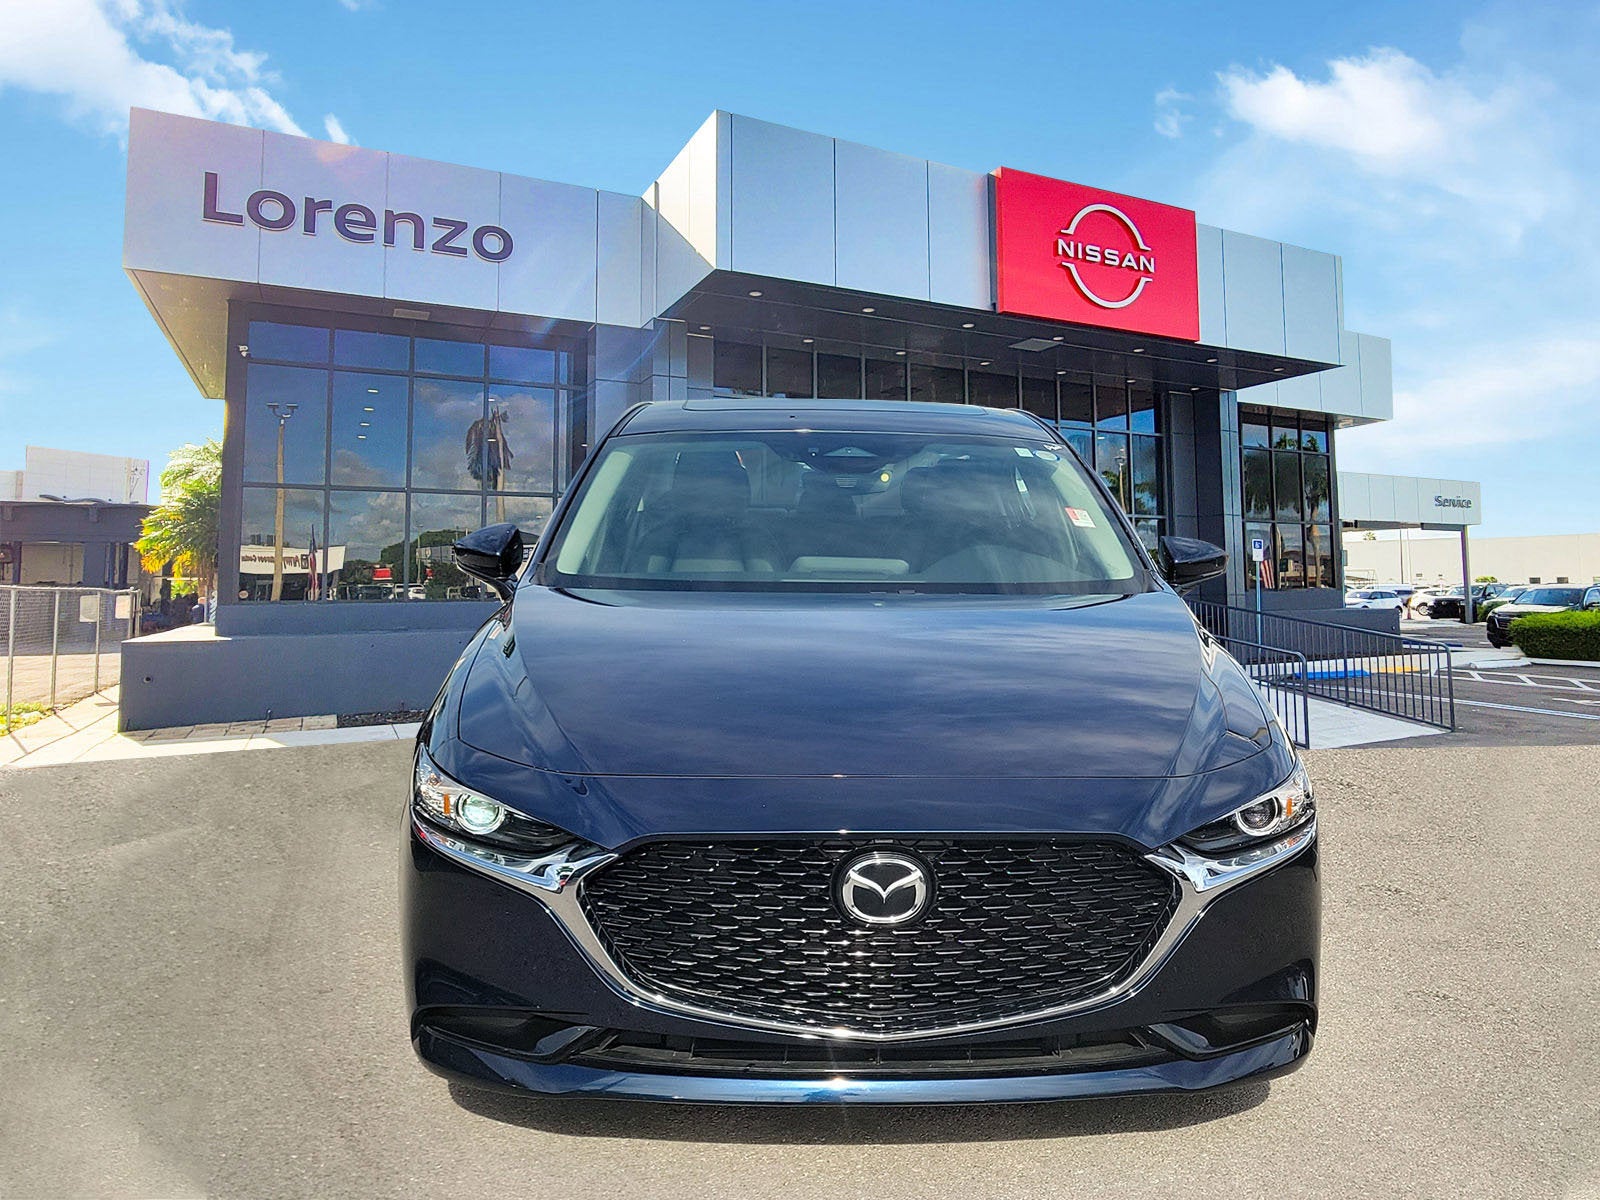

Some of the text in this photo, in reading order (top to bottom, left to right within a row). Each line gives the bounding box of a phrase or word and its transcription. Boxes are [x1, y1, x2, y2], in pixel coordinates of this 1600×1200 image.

[202, 171, 514, 262] Lorenzo
[1057, 238, 1155, 273] NISSAN
[1434, 495, 1472, 509] Service
